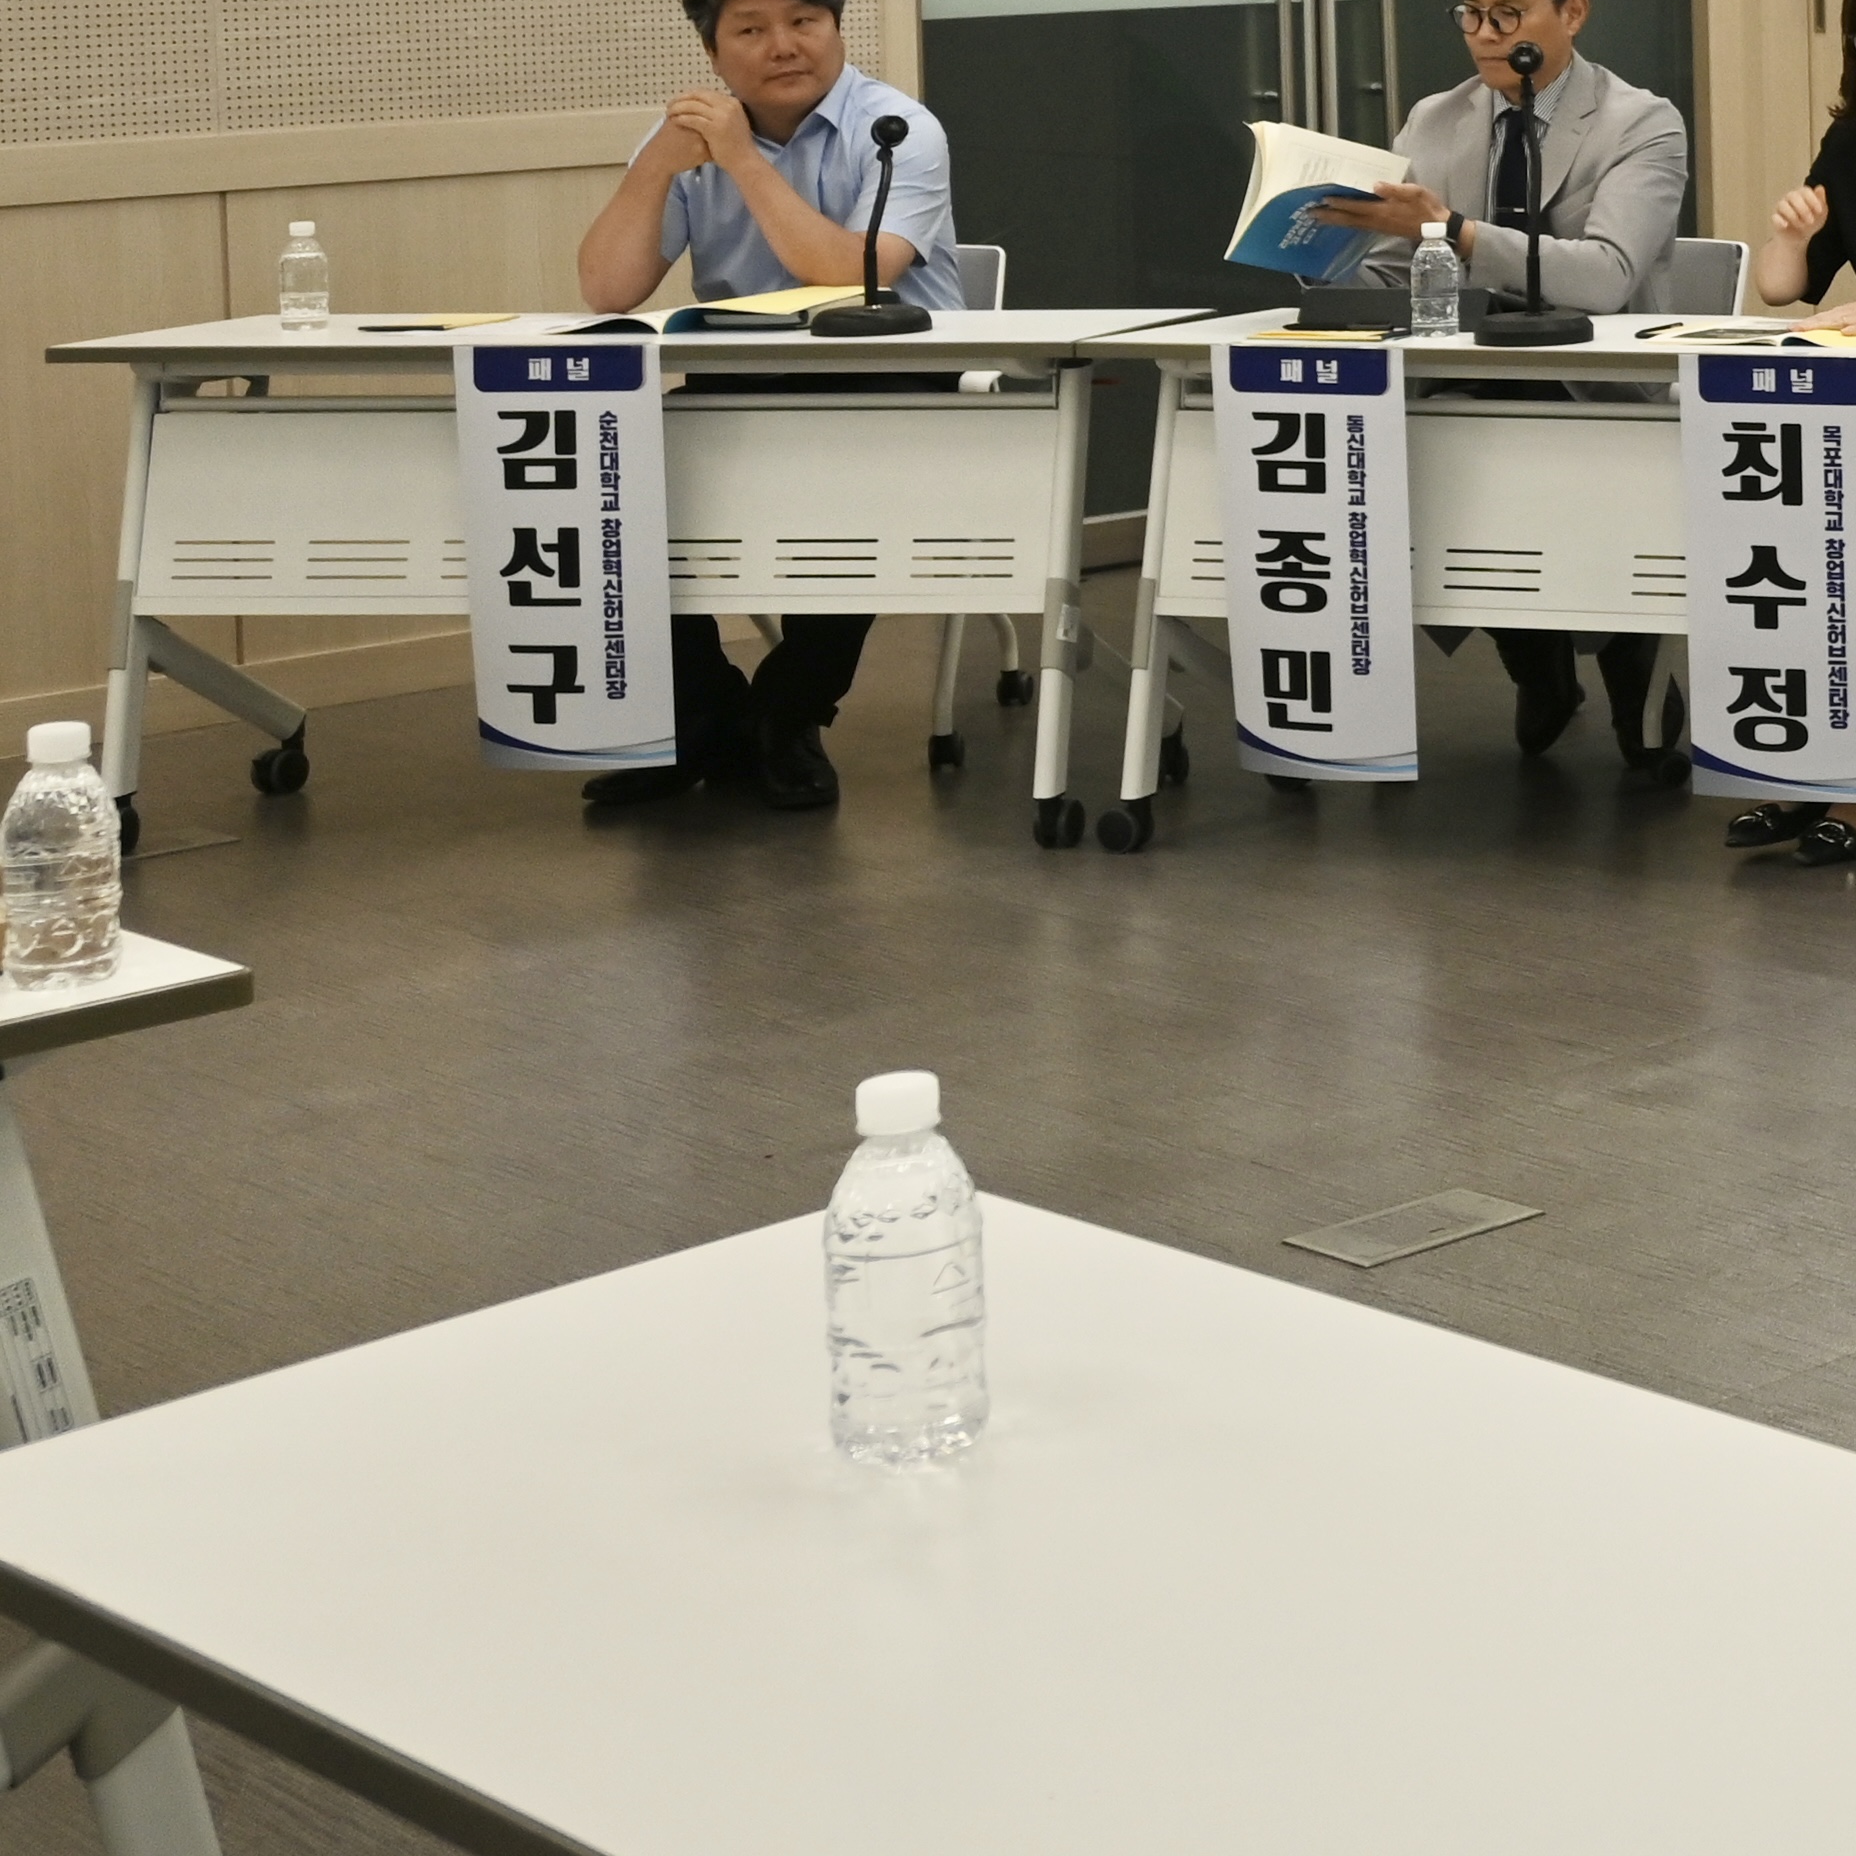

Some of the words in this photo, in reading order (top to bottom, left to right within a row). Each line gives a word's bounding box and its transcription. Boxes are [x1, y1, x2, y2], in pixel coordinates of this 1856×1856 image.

[598, 410, 621, 512] 순천대학교
[1346, 414, 1367, 506] 동신대학교
[1822, 425, 1845, 532] 목포대학교
[496, 409, 586, 725] 김선구
[1247, 411, 1334, 735] 김종민
[1721, 421, 1809, 753] 최수정
